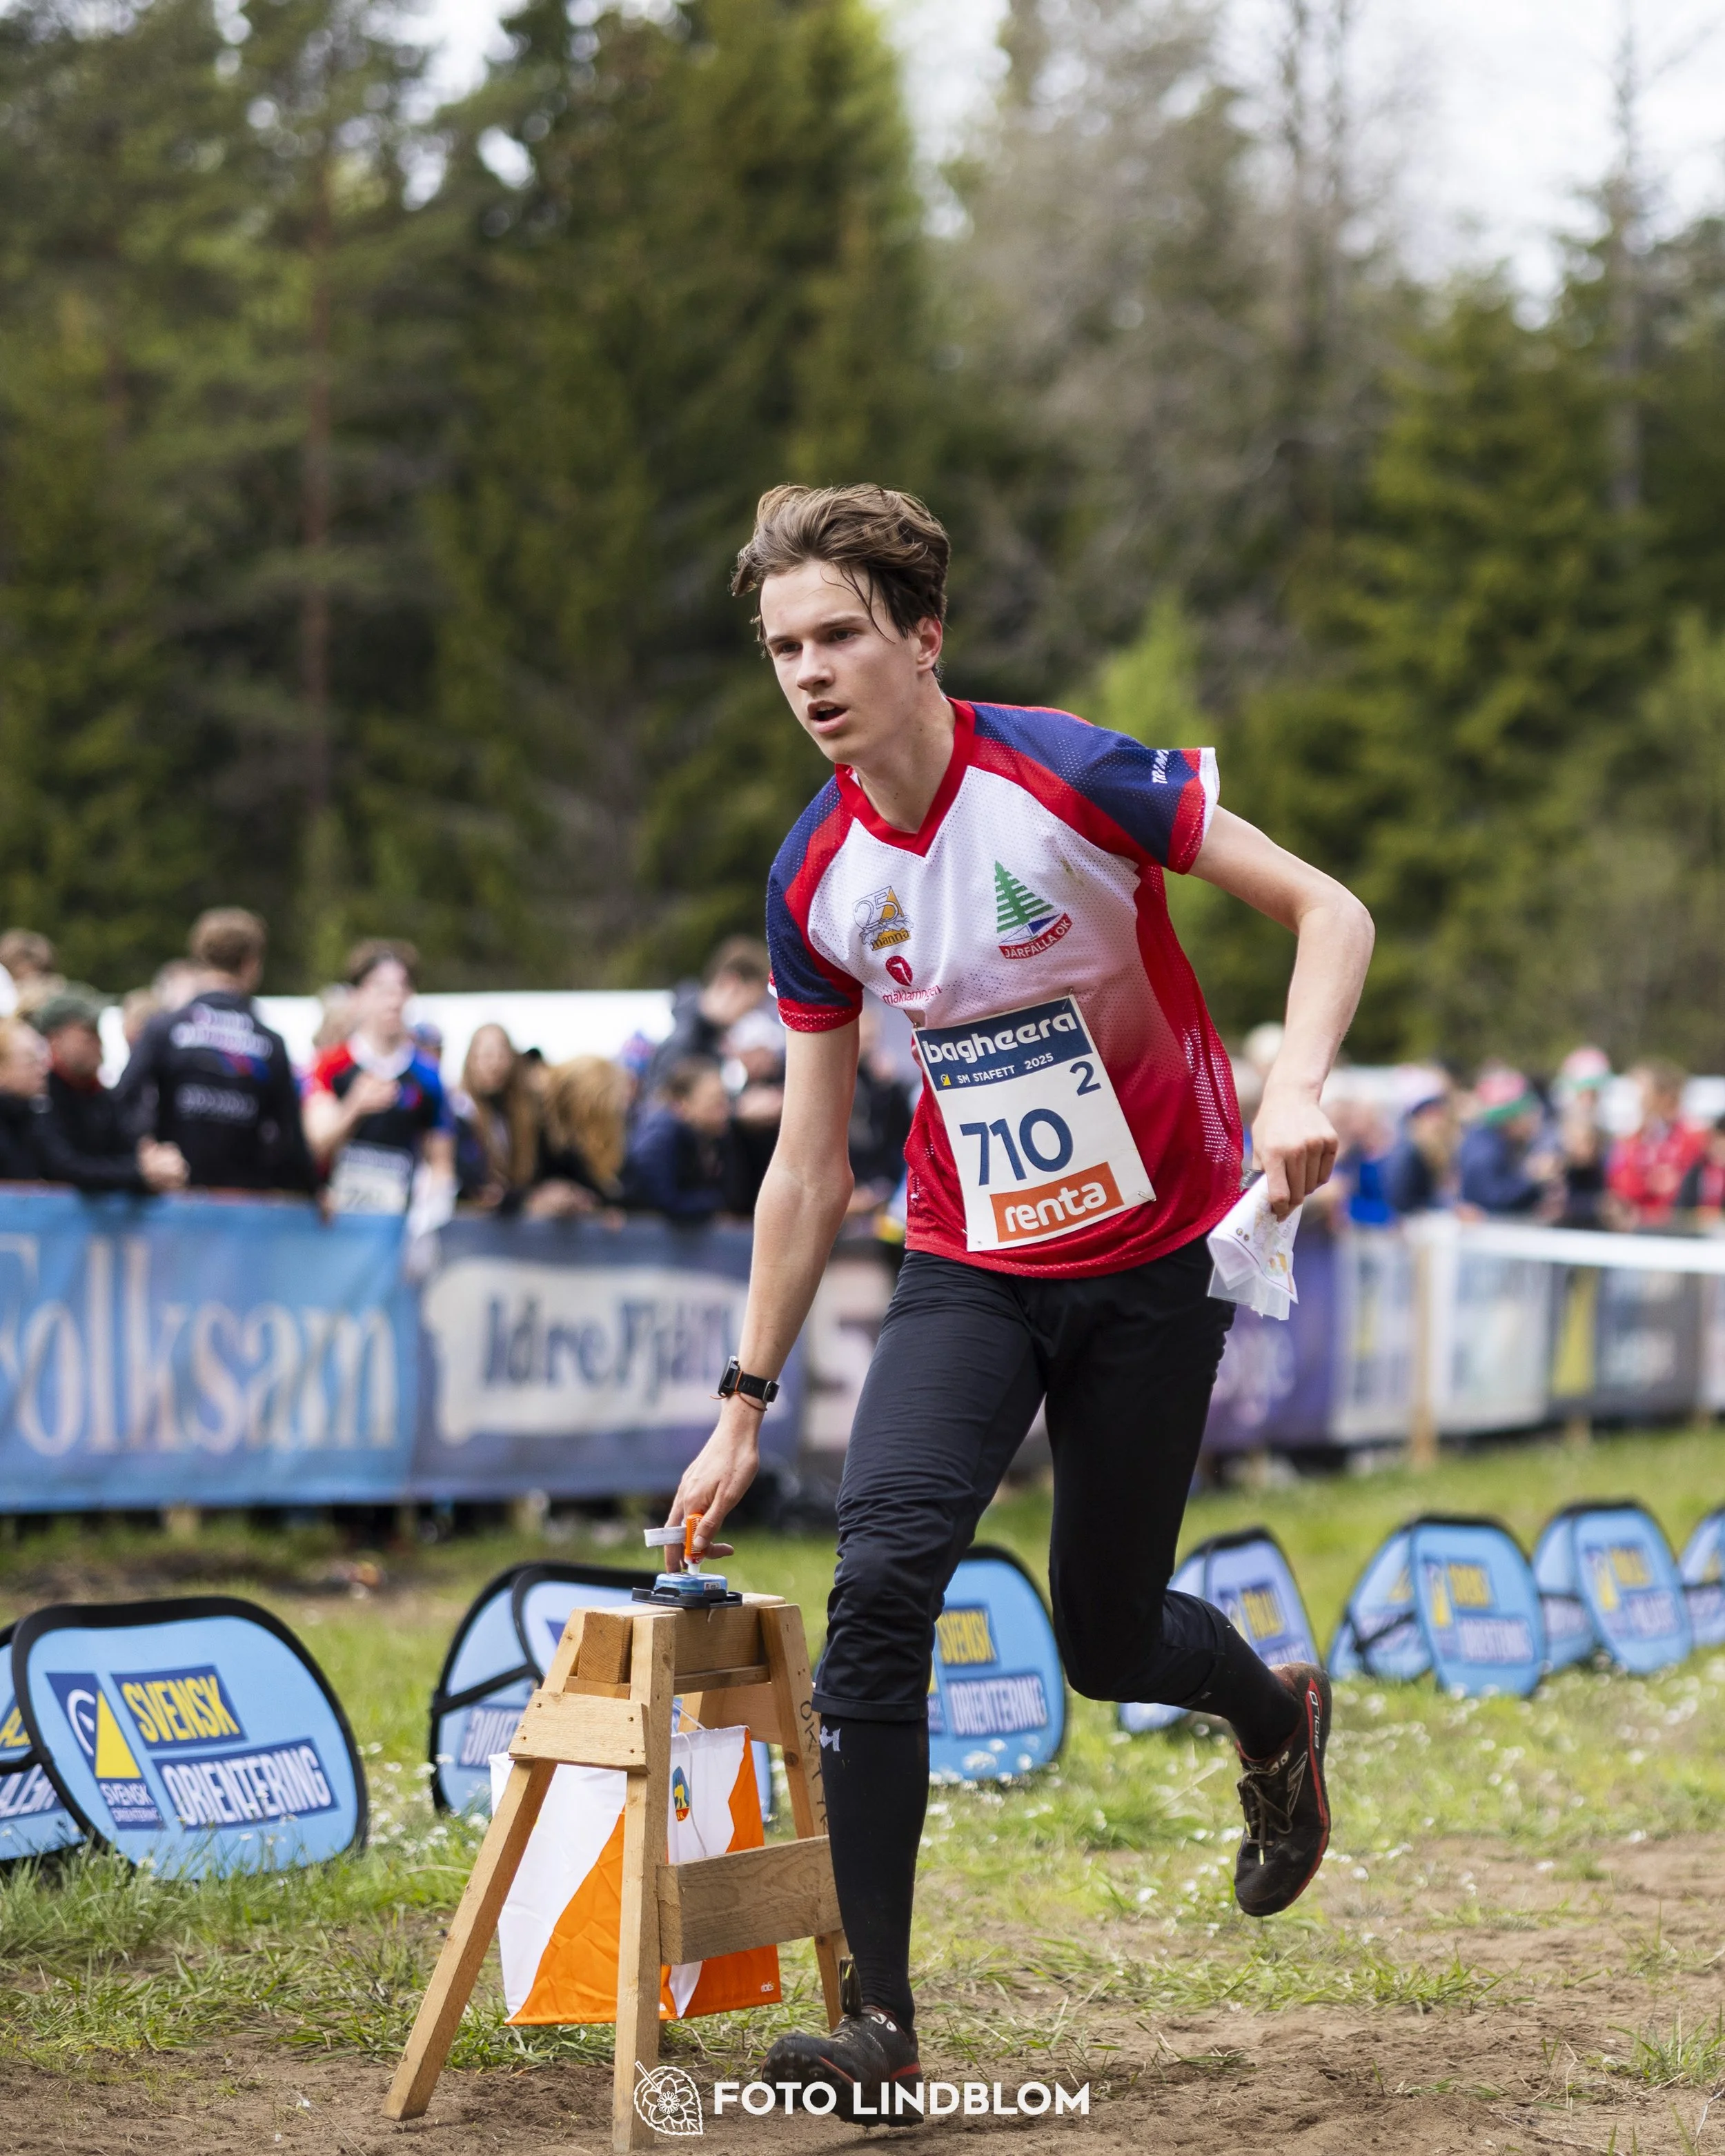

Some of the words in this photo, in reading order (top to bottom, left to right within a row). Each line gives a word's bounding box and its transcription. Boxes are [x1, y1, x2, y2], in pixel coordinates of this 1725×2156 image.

[855, 892, 898, 928] 25
[871, 929, 909, 949] manna
[1005, 934, 1058, 958] JÄRFÄLLA
[1056, 919, 1071, 936] OK
[883, 985, 942, 1005] mäklarringen
[924, 1011, 1078, 1065] bagheera
[957, 1074, 970, 1083] SM
[974, 1065, 1016, 1082] STAFETT
[1024, 1053, 1054, 1070] 2025
[1070, 1060, 1102, 1096] 2
[960, 1108, 1074, 1186] 710
[1005, 1180, 1107, 1233] renta
[122, 1674, 240, 1743] SVENSK
[99, 1782, 155, 1806] SVENSK
[162, 1745, 332, 1826] ORIENTERING
